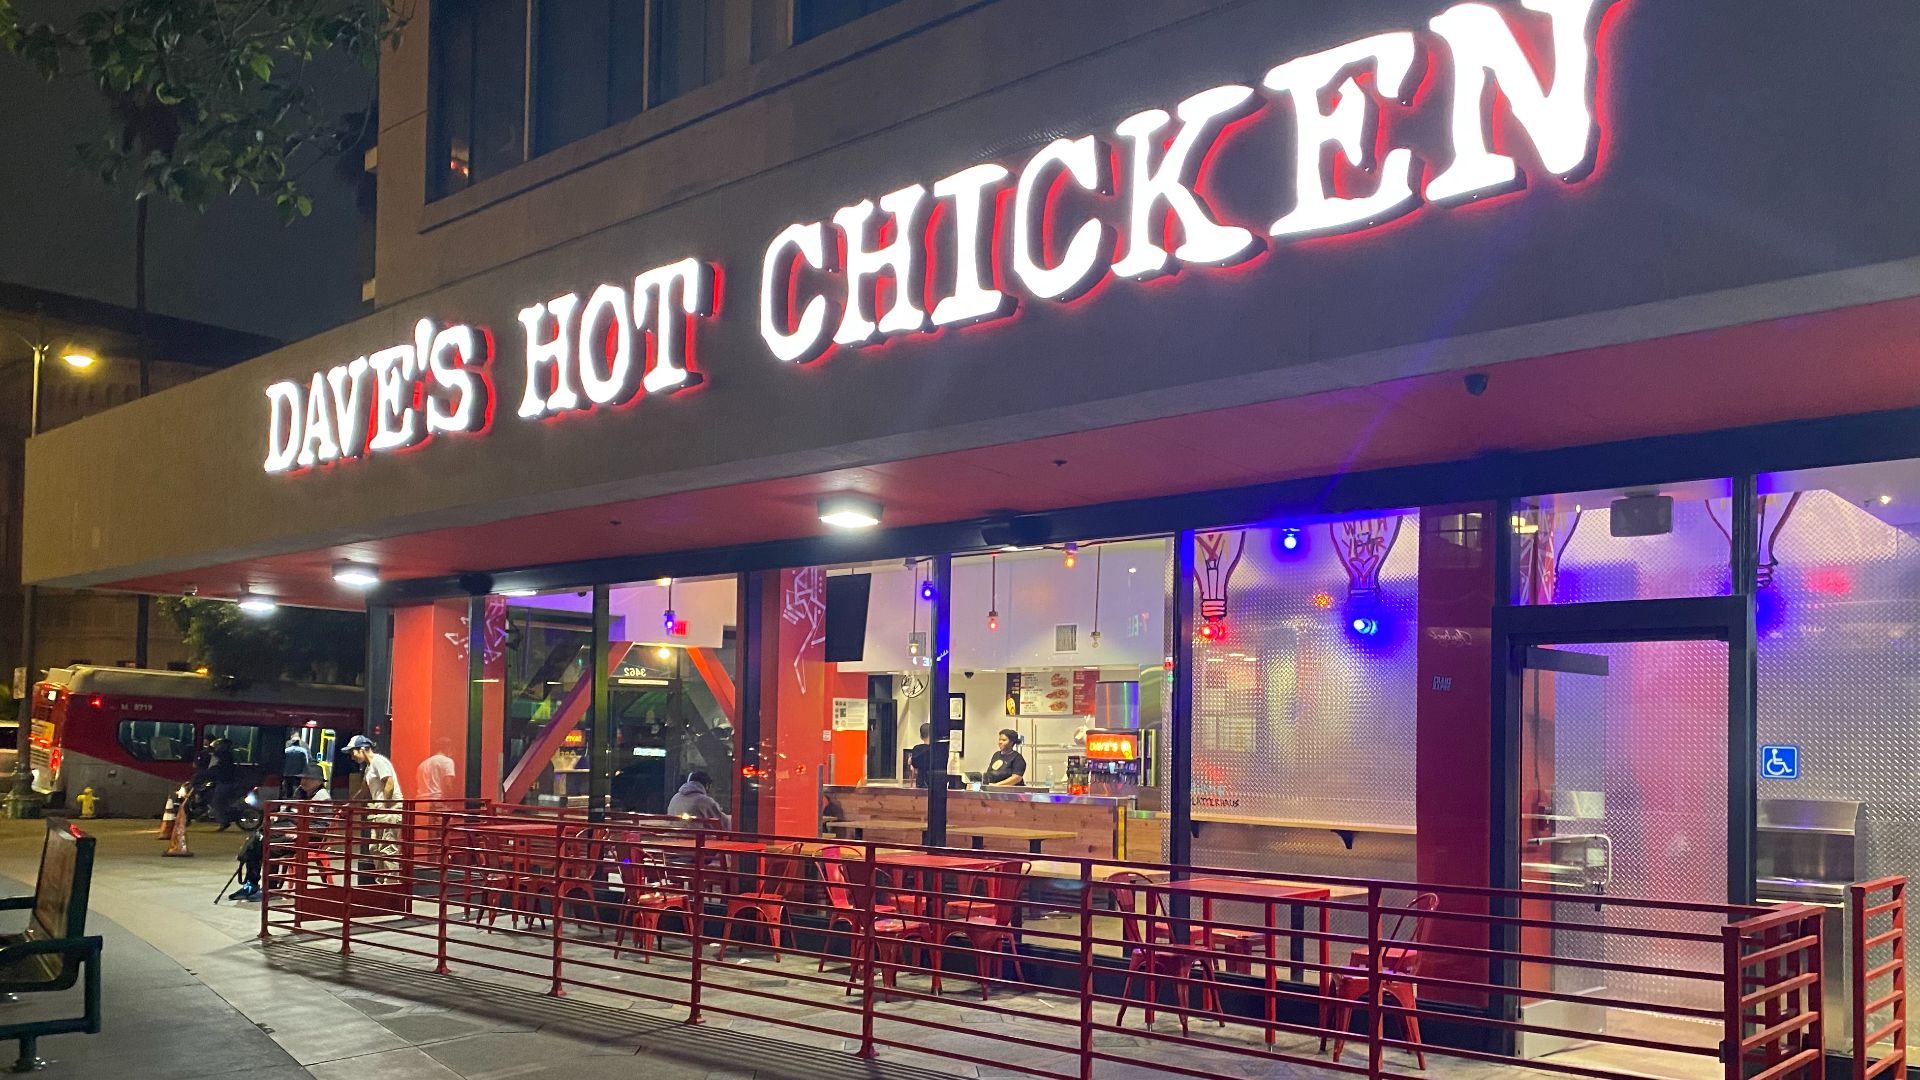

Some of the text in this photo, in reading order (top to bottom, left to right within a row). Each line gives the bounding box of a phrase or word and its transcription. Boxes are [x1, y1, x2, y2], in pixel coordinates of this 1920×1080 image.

[263, 0, 1608, 473] DAVE'S HOT CHICKEN
